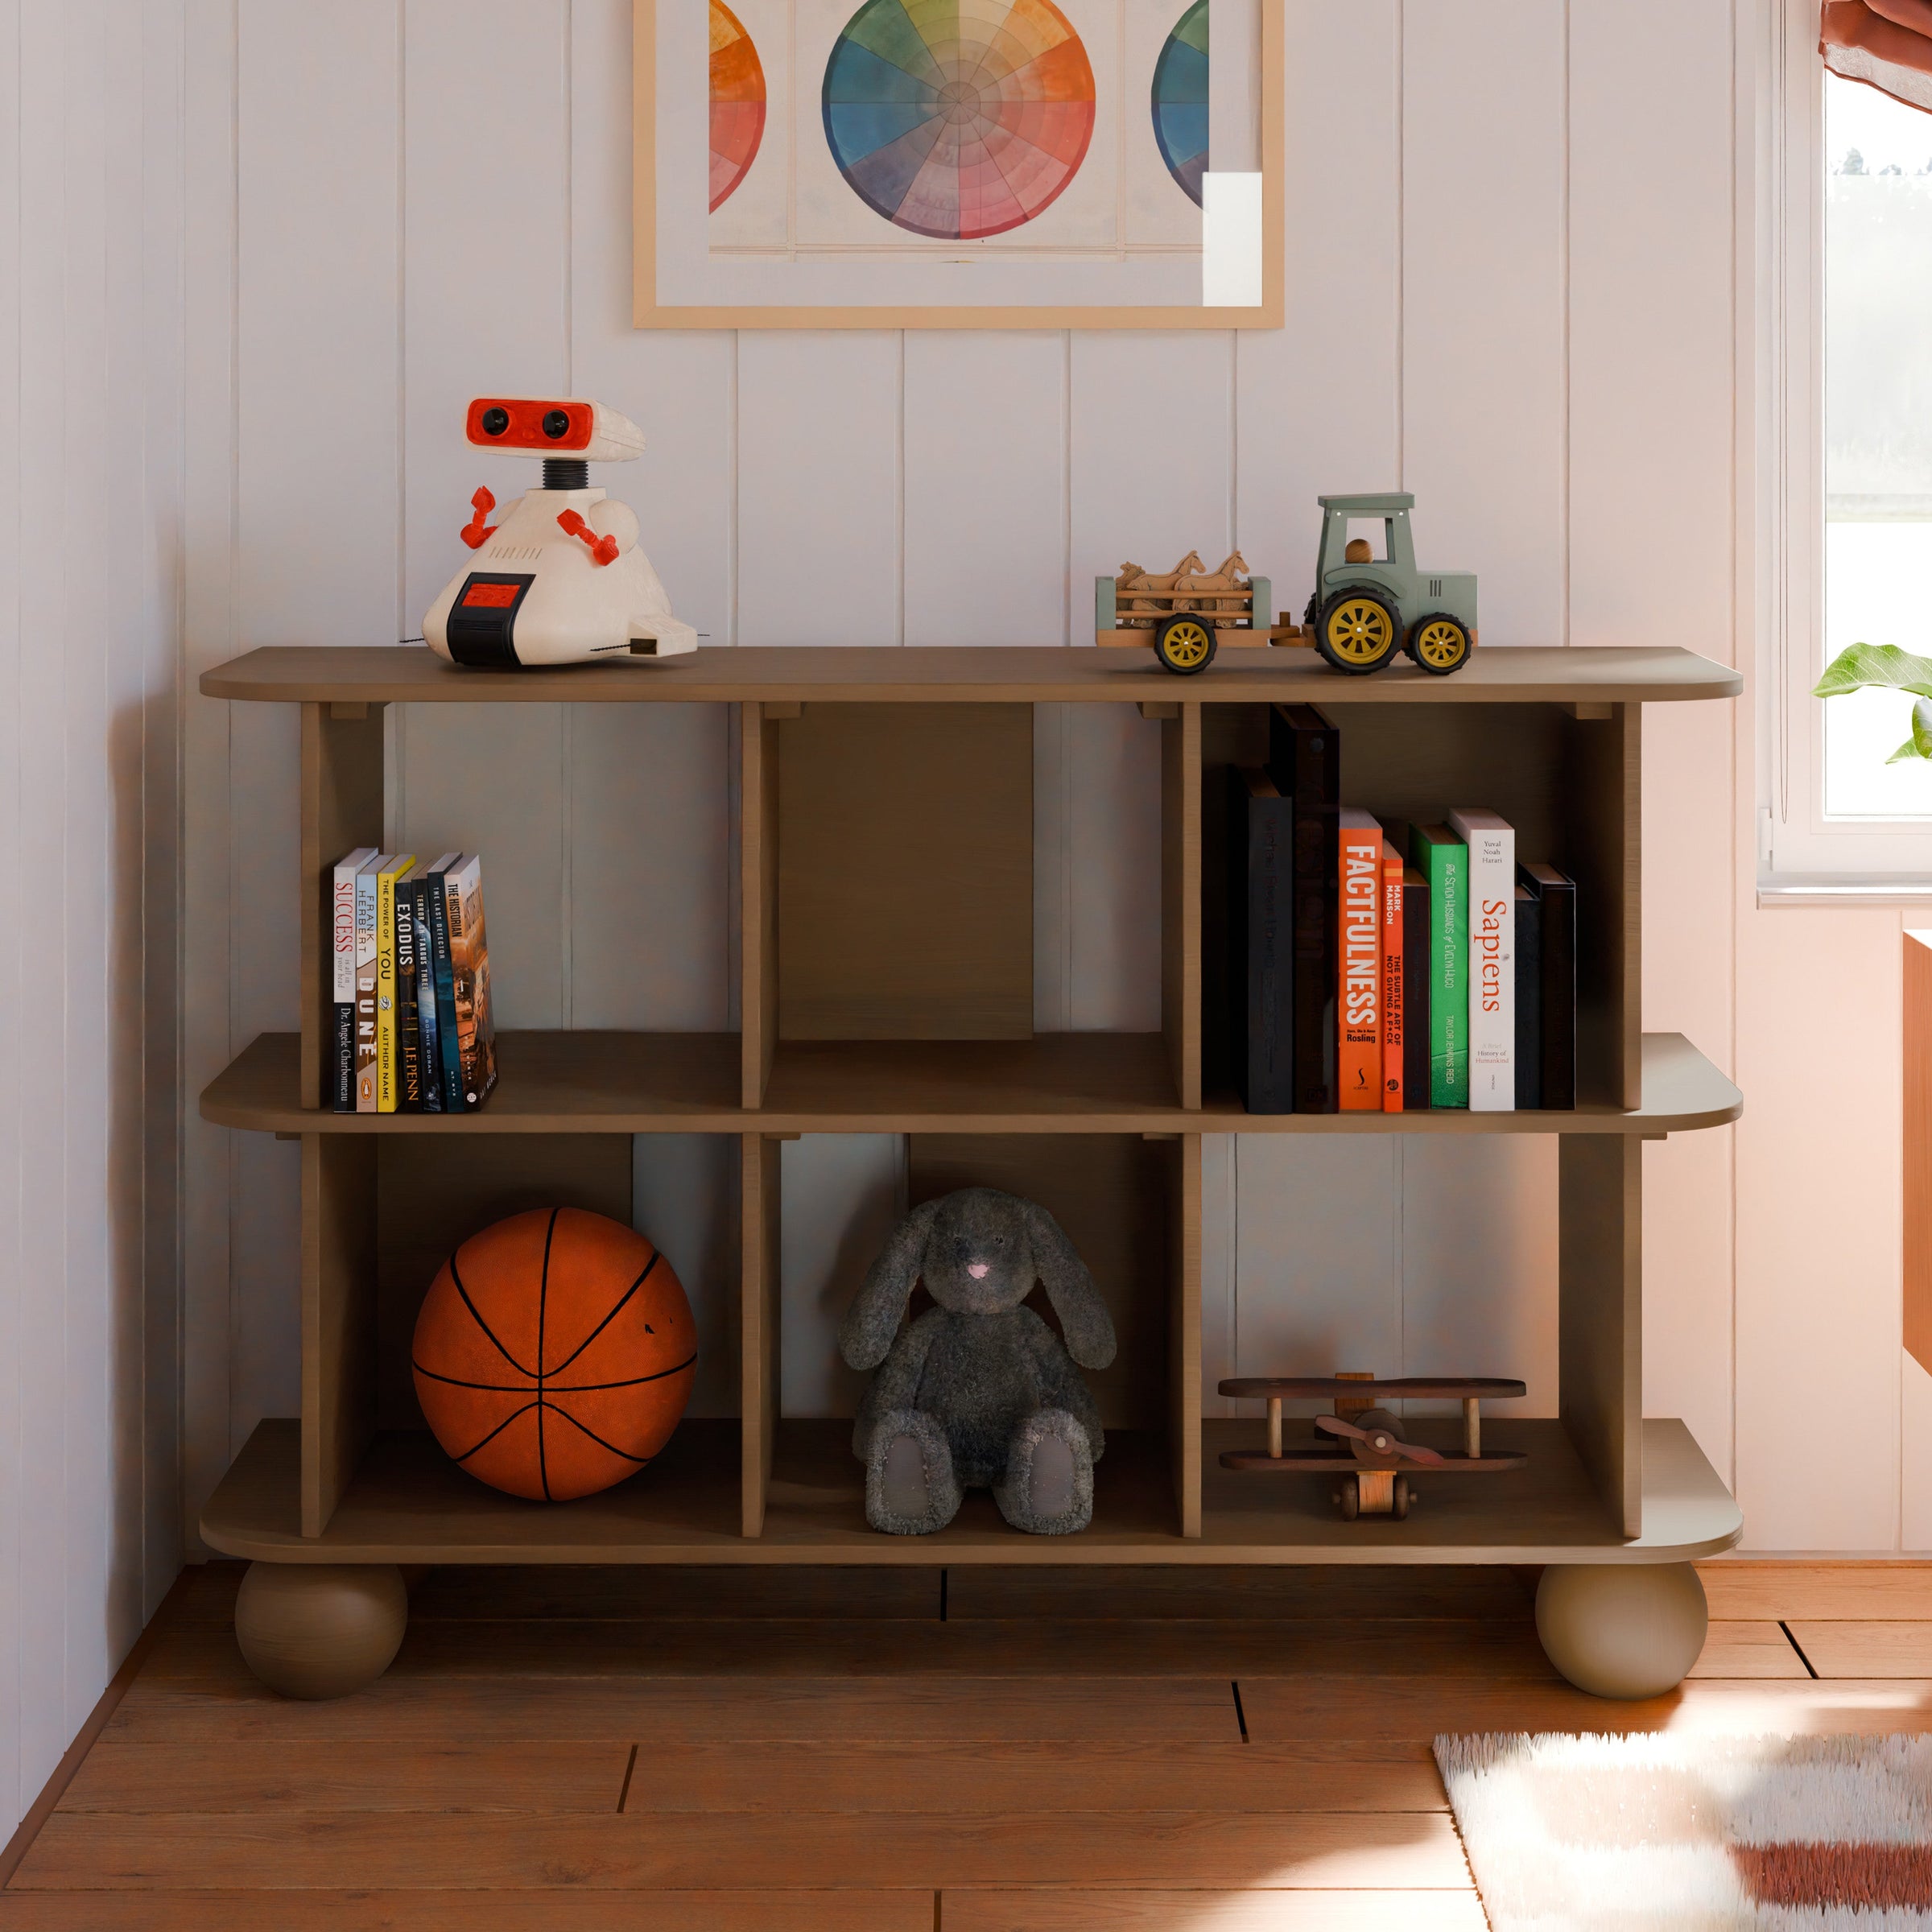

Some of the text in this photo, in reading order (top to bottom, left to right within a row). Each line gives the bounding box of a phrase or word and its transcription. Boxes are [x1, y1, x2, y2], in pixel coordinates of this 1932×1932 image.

[1444, 877, 1455, 898] SEVEN
[1446, 864, 1455, 875] The
[335, 882, 353, 952] SUCCESS
[448, 884, 462, 938] THE HISTORIAN
[1444, 900, 1455, 934] HUSBANDS
[383, 929, 389, 939] OF
[397, 904, 413, 965] EXODUS
[416, 894, 429, 991] TERROR ON TARGUS THREE
[436, 923, 444, 960] DEFECTOR
[1346, 845, 1376, 1025] FACTFULNESS
[1444, 944, 1455, 968] EVELYN
[1474, 900, 1507, 1012] Sapiens
[382, 947, 390, 980] YOU
[1444, 970, 1455, 989] HUGO
[359, 977, 374, 1056] DUNE
[1347, 1034, 1376, 1043] Rosling
[338, 1008, 351, 1101] Dr. Angele Charbonneau
[1394, 1034, 1401, 1046] OF
[1446, 1015, 1454, 1084] TAYLOR JENKINS REID
[403, 1046, 419, 1100] J.F. PENN
